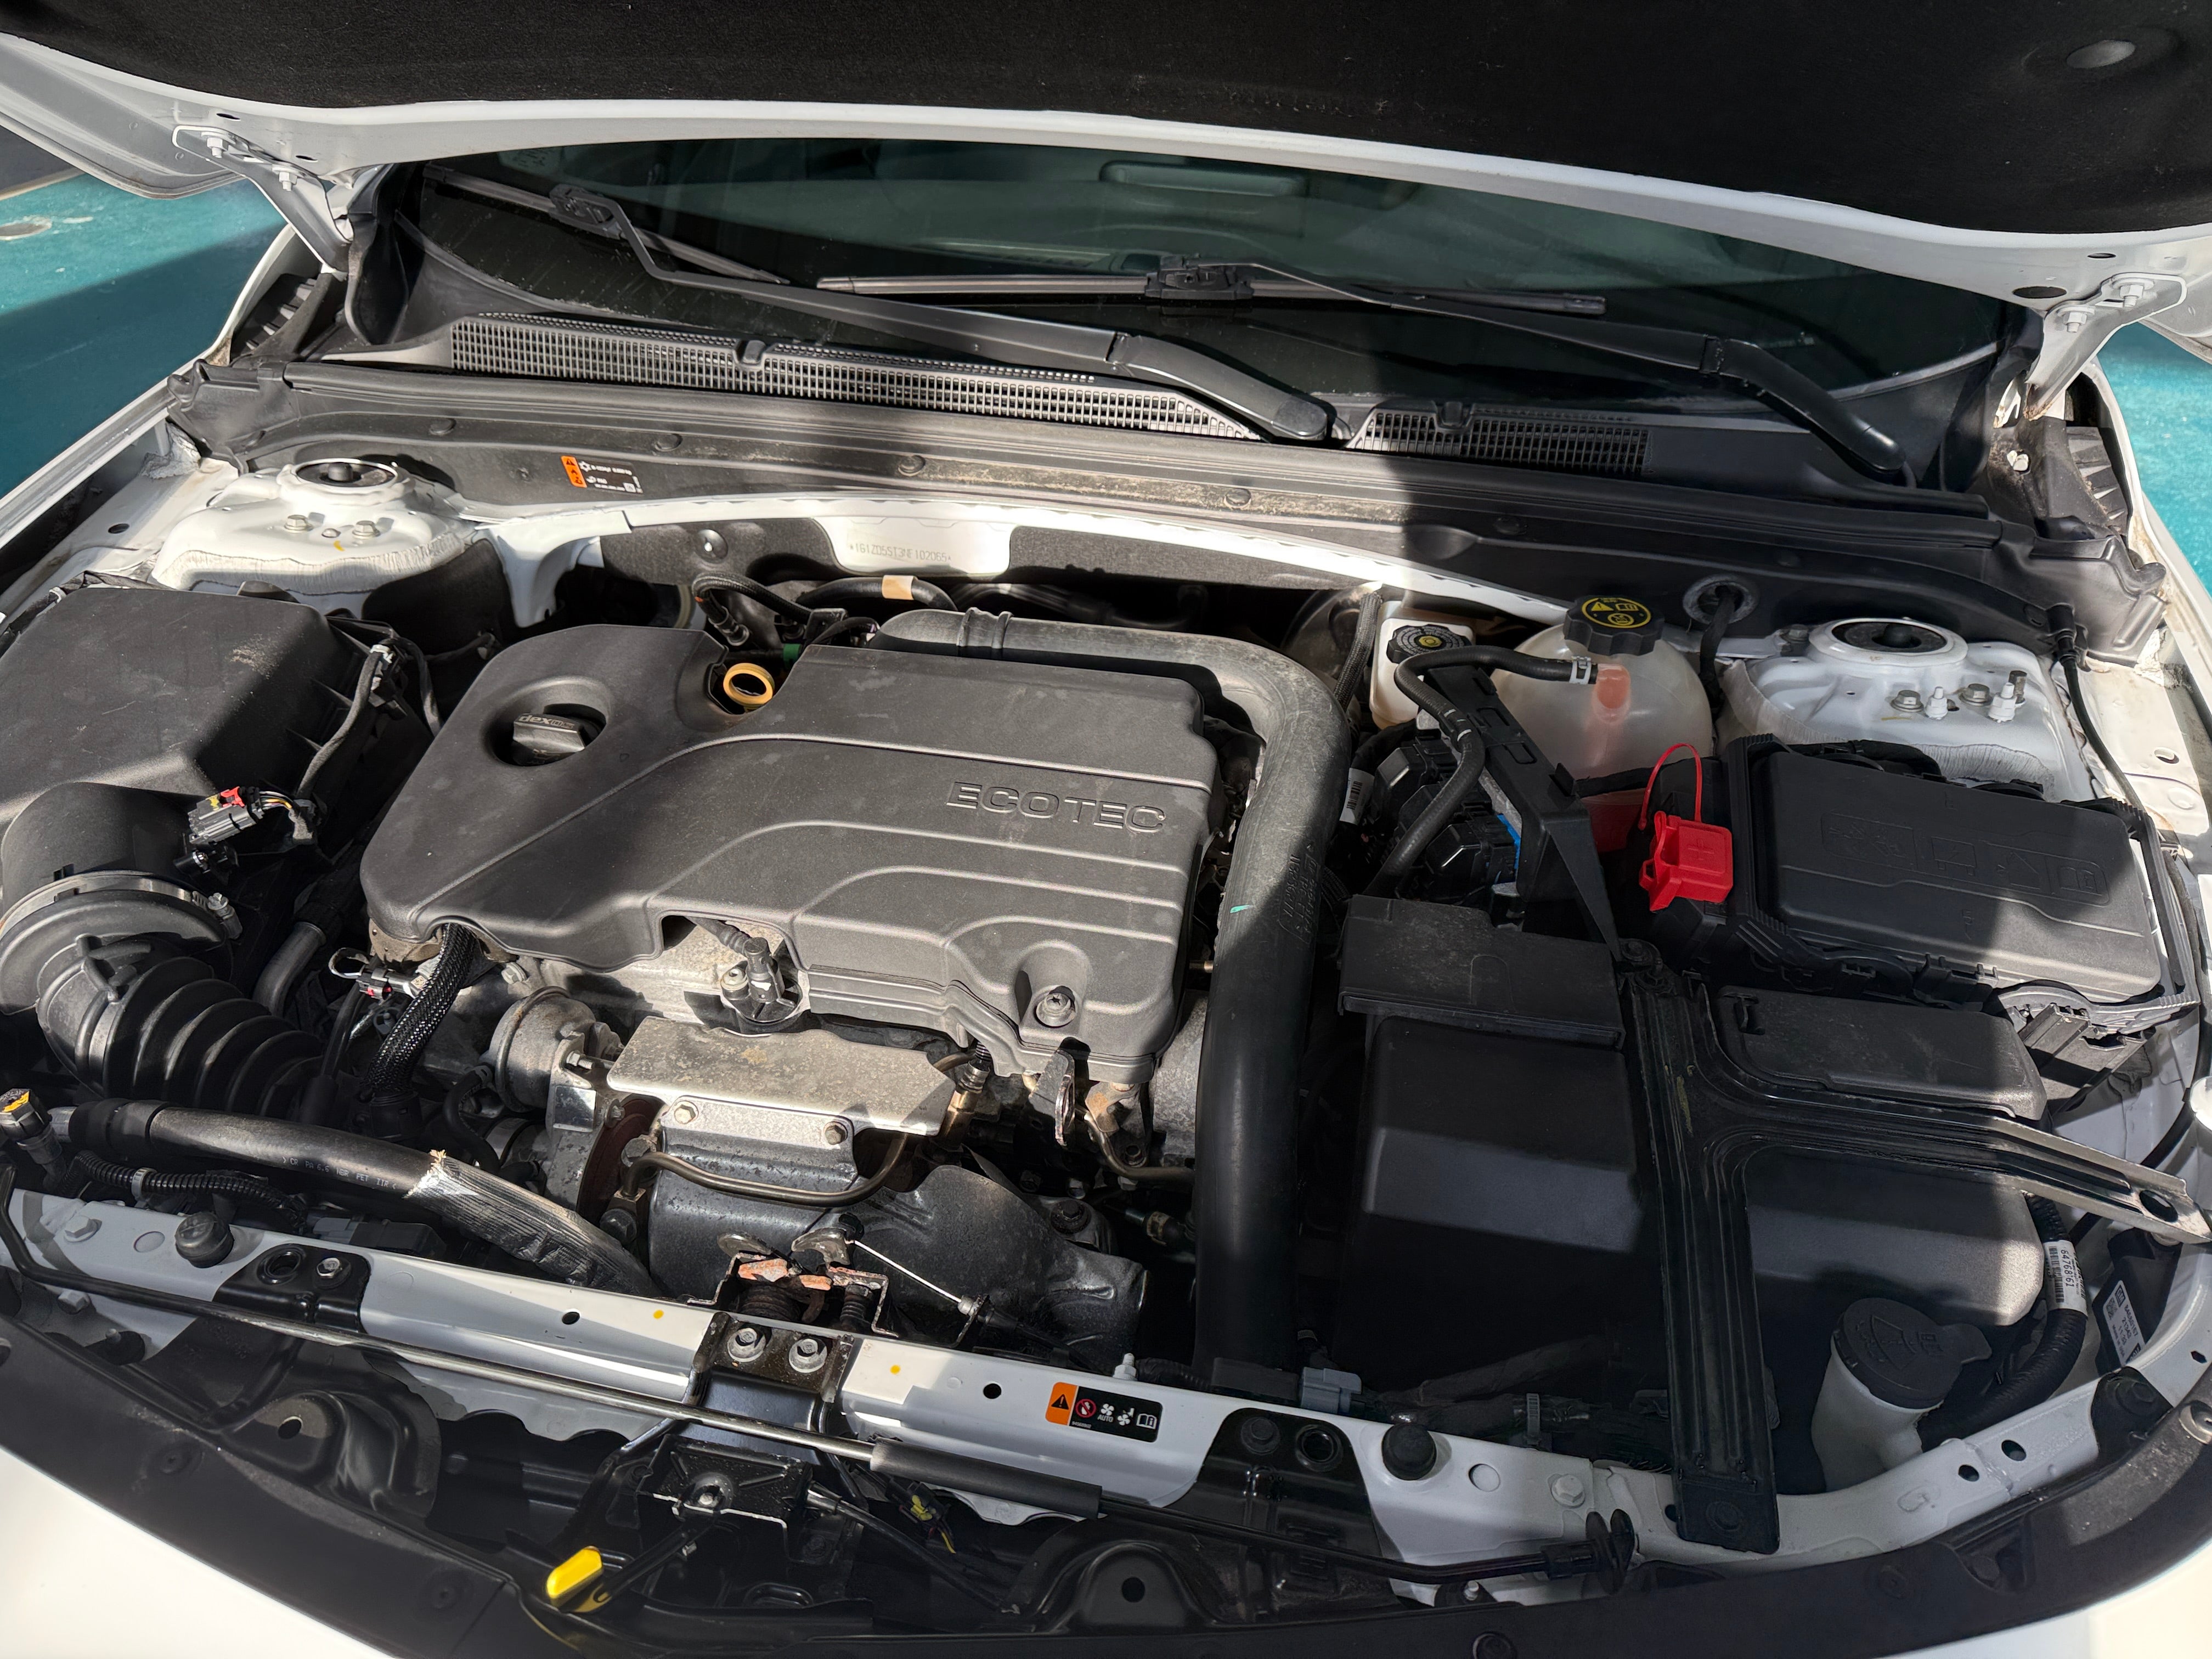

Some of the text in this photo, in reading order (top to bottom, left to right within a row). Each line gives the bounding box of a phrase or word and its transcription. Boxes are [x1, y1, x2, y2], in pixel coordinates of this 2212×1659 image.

[518, 715, 575, 729] dexos
[946, 781, 1166, 833] ECOTEC
[290, 1158, 298, 1166] CR
[356, 1172, 369, 1182] PET
